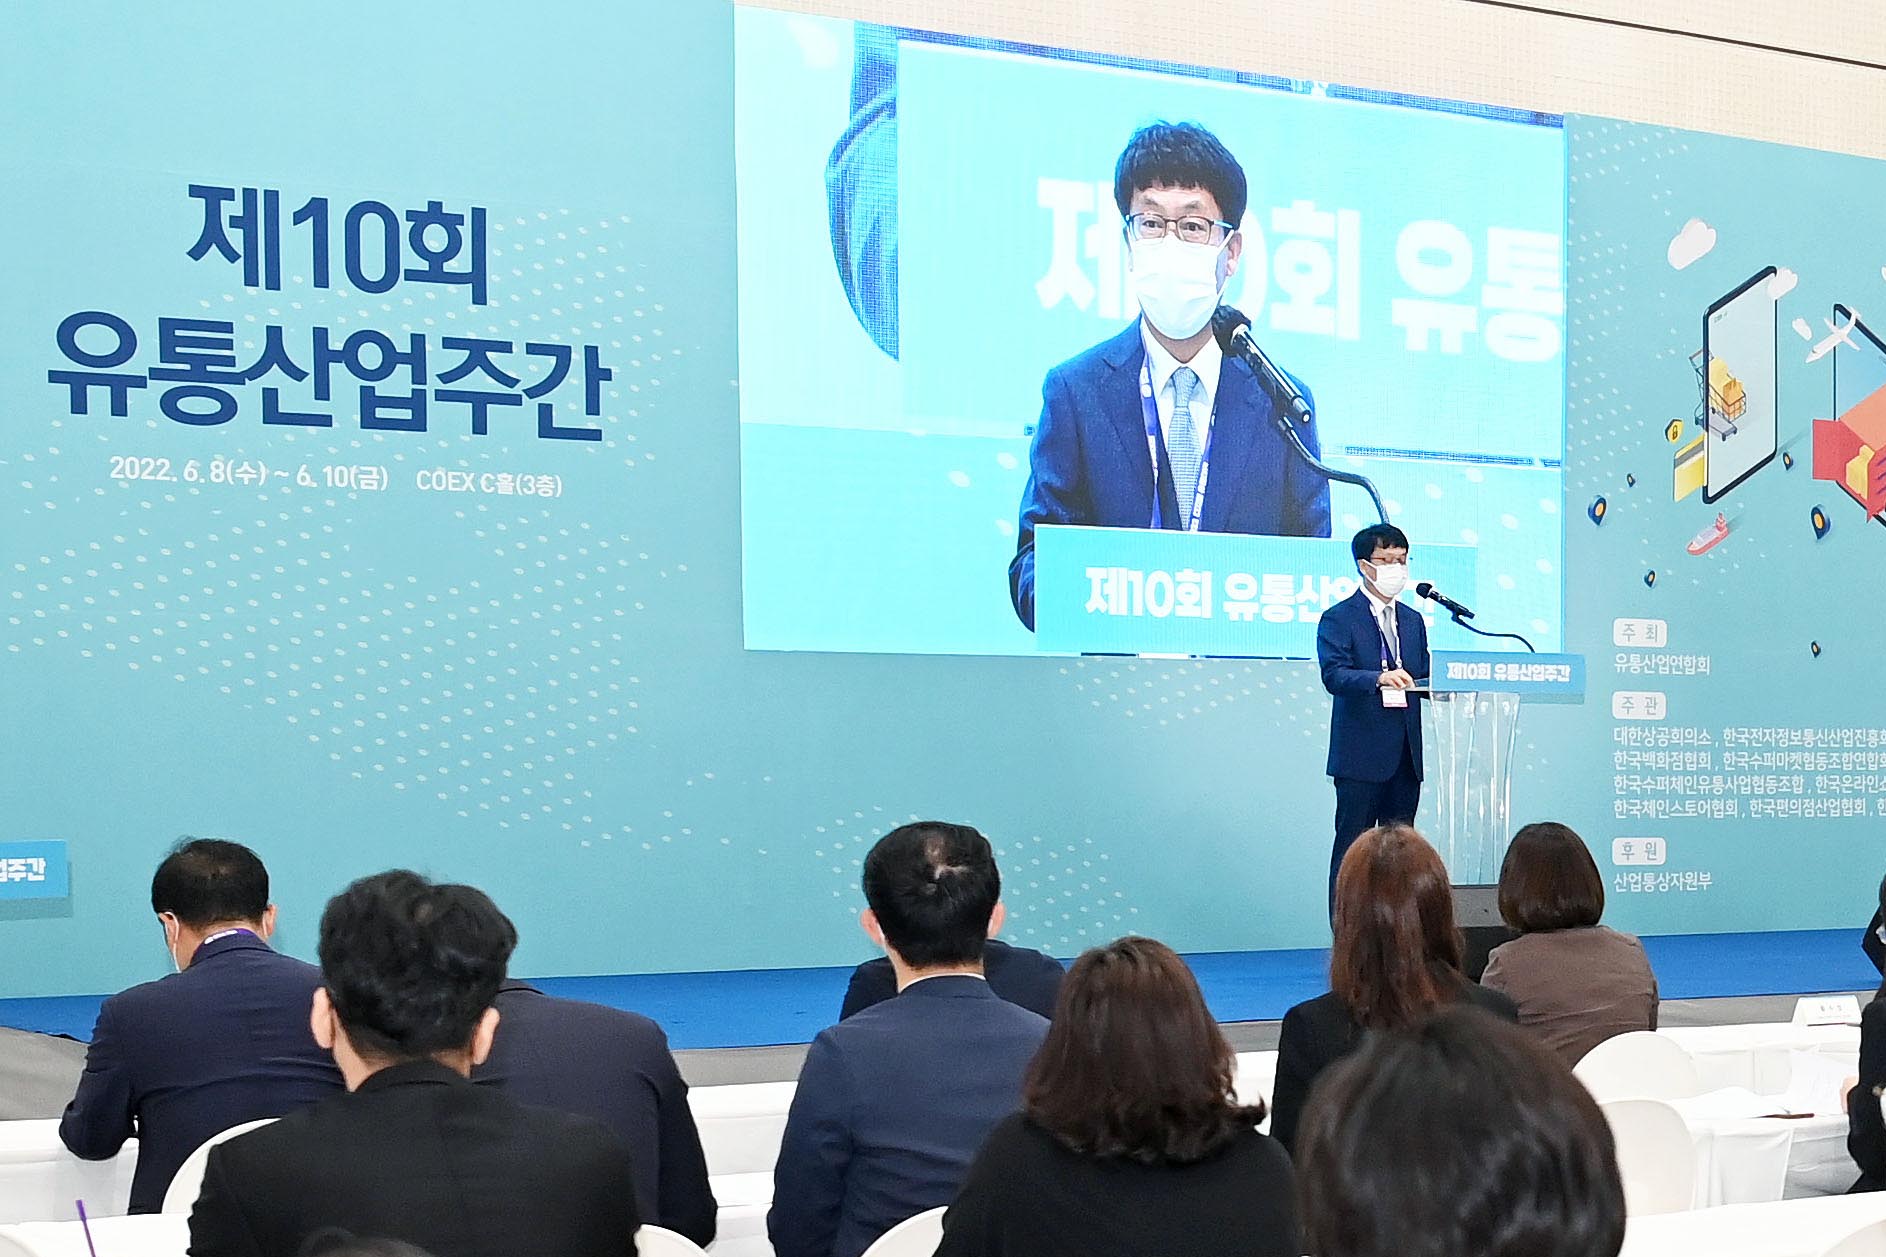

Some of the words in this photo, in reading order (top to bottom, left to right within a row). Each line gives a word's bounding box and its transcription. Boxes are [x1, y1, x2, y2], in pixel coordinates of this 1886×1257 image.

[186, 184, 488, 305] 제10회
[1035, 176, 1361, 341] 제회
[1392, 220, 1564, 362] 유통
[47, 311, 612, 441] 유통산업주간
[109, 455, 178, 482] 2022.
[210, 459, 266, 486] 8(수)
[322, 465, 388, 491] 10(금)
[416, 469, 475, 492] COEX
[480, 473, 562, 497] C홀(3층)
[1085, 567, 1212, 619] 제10회
[1224, 573, 1435, 627] 유통산
[1446, 662, 1491, 680] 제10회
[1494, 663, 1571, 682] 유통산업주간
[1614, 653, 1710, 675] 유통산업연합회
[1614, 871, 1713, 893] 산업통상자원부
